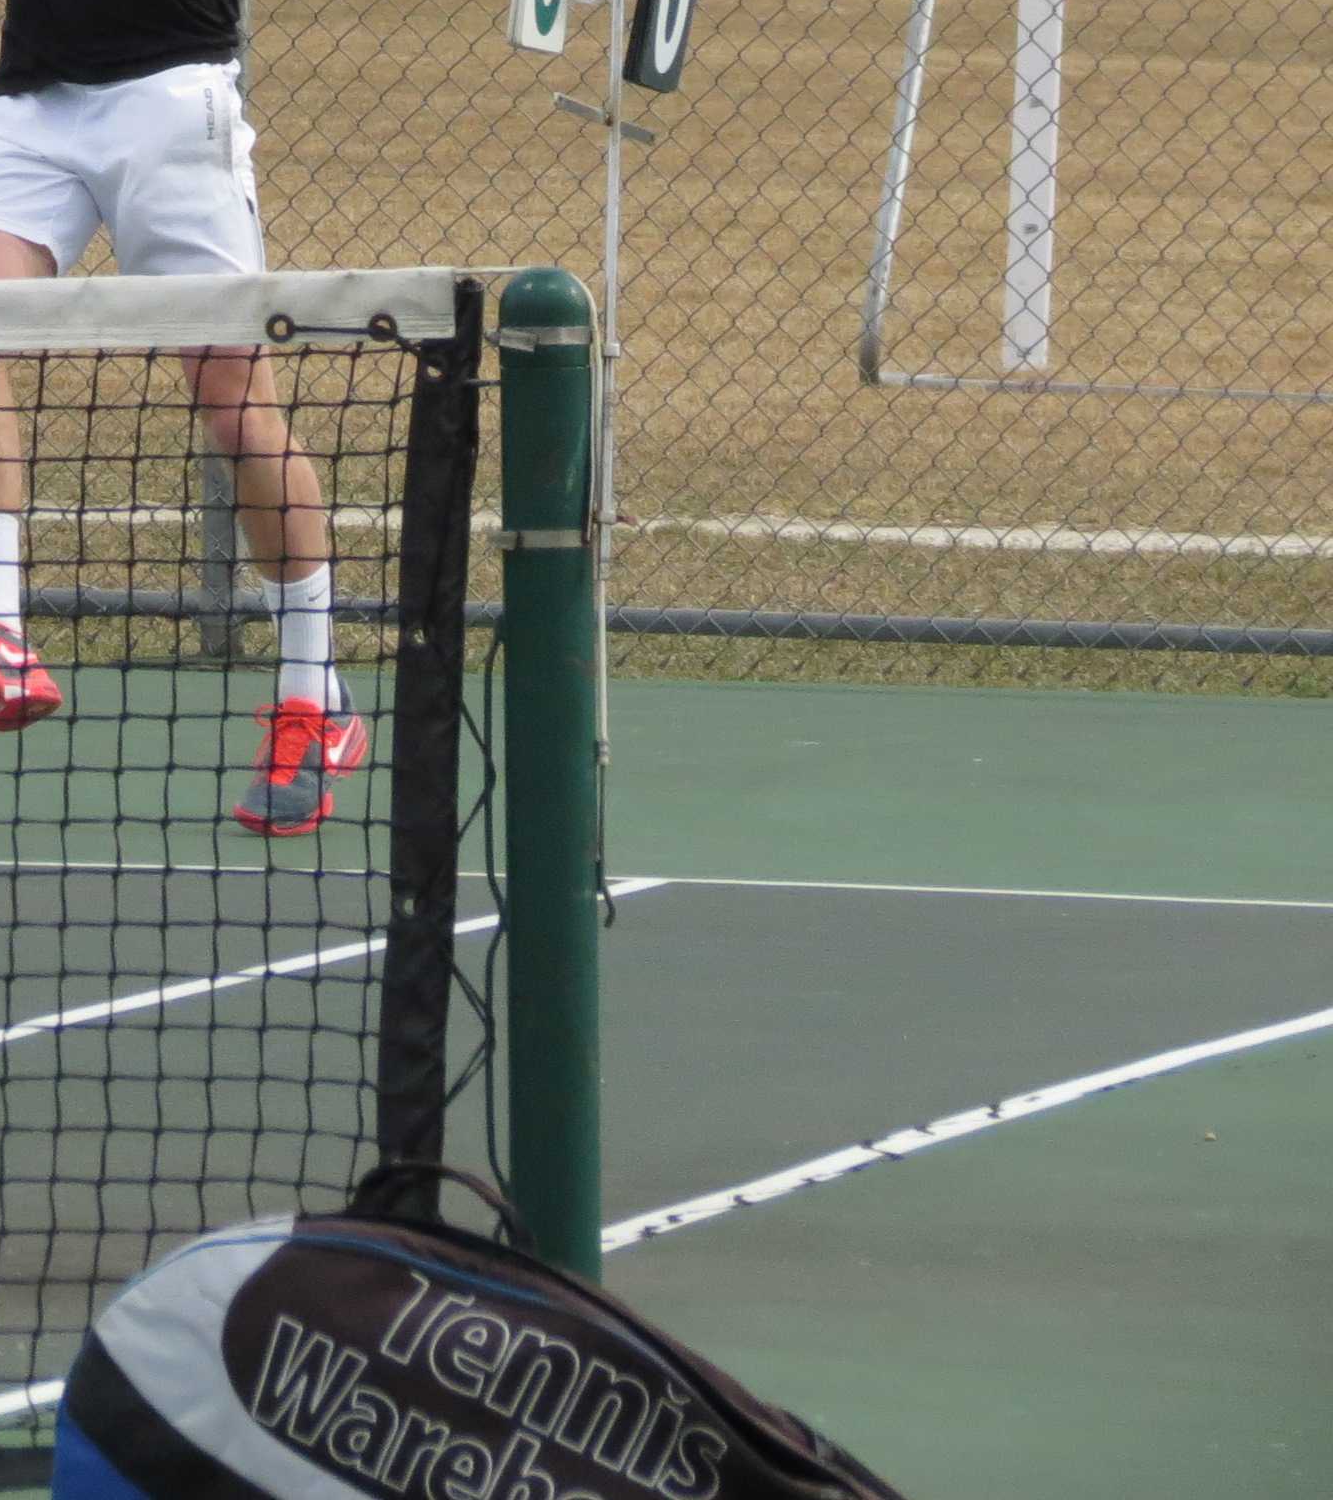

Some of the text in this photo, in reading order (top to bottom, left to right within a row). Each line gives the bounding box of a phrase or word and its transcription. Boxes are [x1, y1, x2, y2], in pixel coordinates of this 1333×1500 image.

[204, 87, 215, 140] HEAD
[252, 1314, 604, 1500] Wareh
[380, 1272, 728, 1500] Tennis
